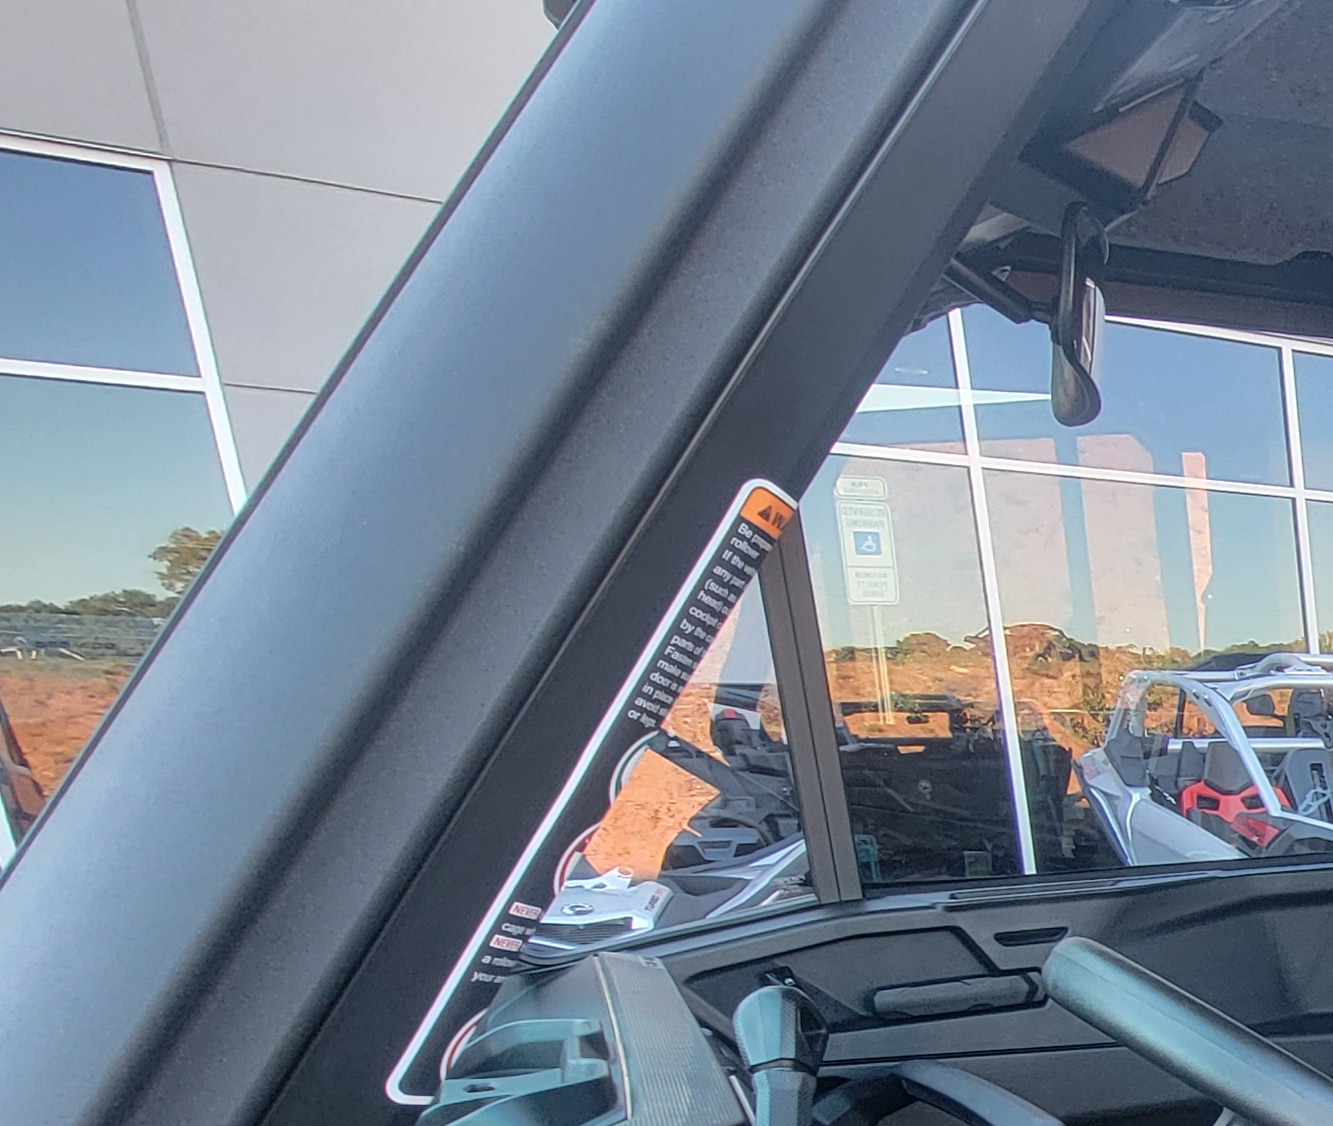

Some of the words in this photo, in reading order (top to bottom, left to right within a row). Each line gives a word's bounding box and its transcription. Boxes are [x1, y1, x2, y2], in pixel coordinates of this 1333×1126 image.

[737, 522, 753, 539] Be
[712, 565, 733, 582] any
[679, 618, 695, 635] by
[649, 672, 672, 688] door
[641, 682, 654, 696] in
[627, 709, 642, 720] or
[481, 955, 491, 964] a
